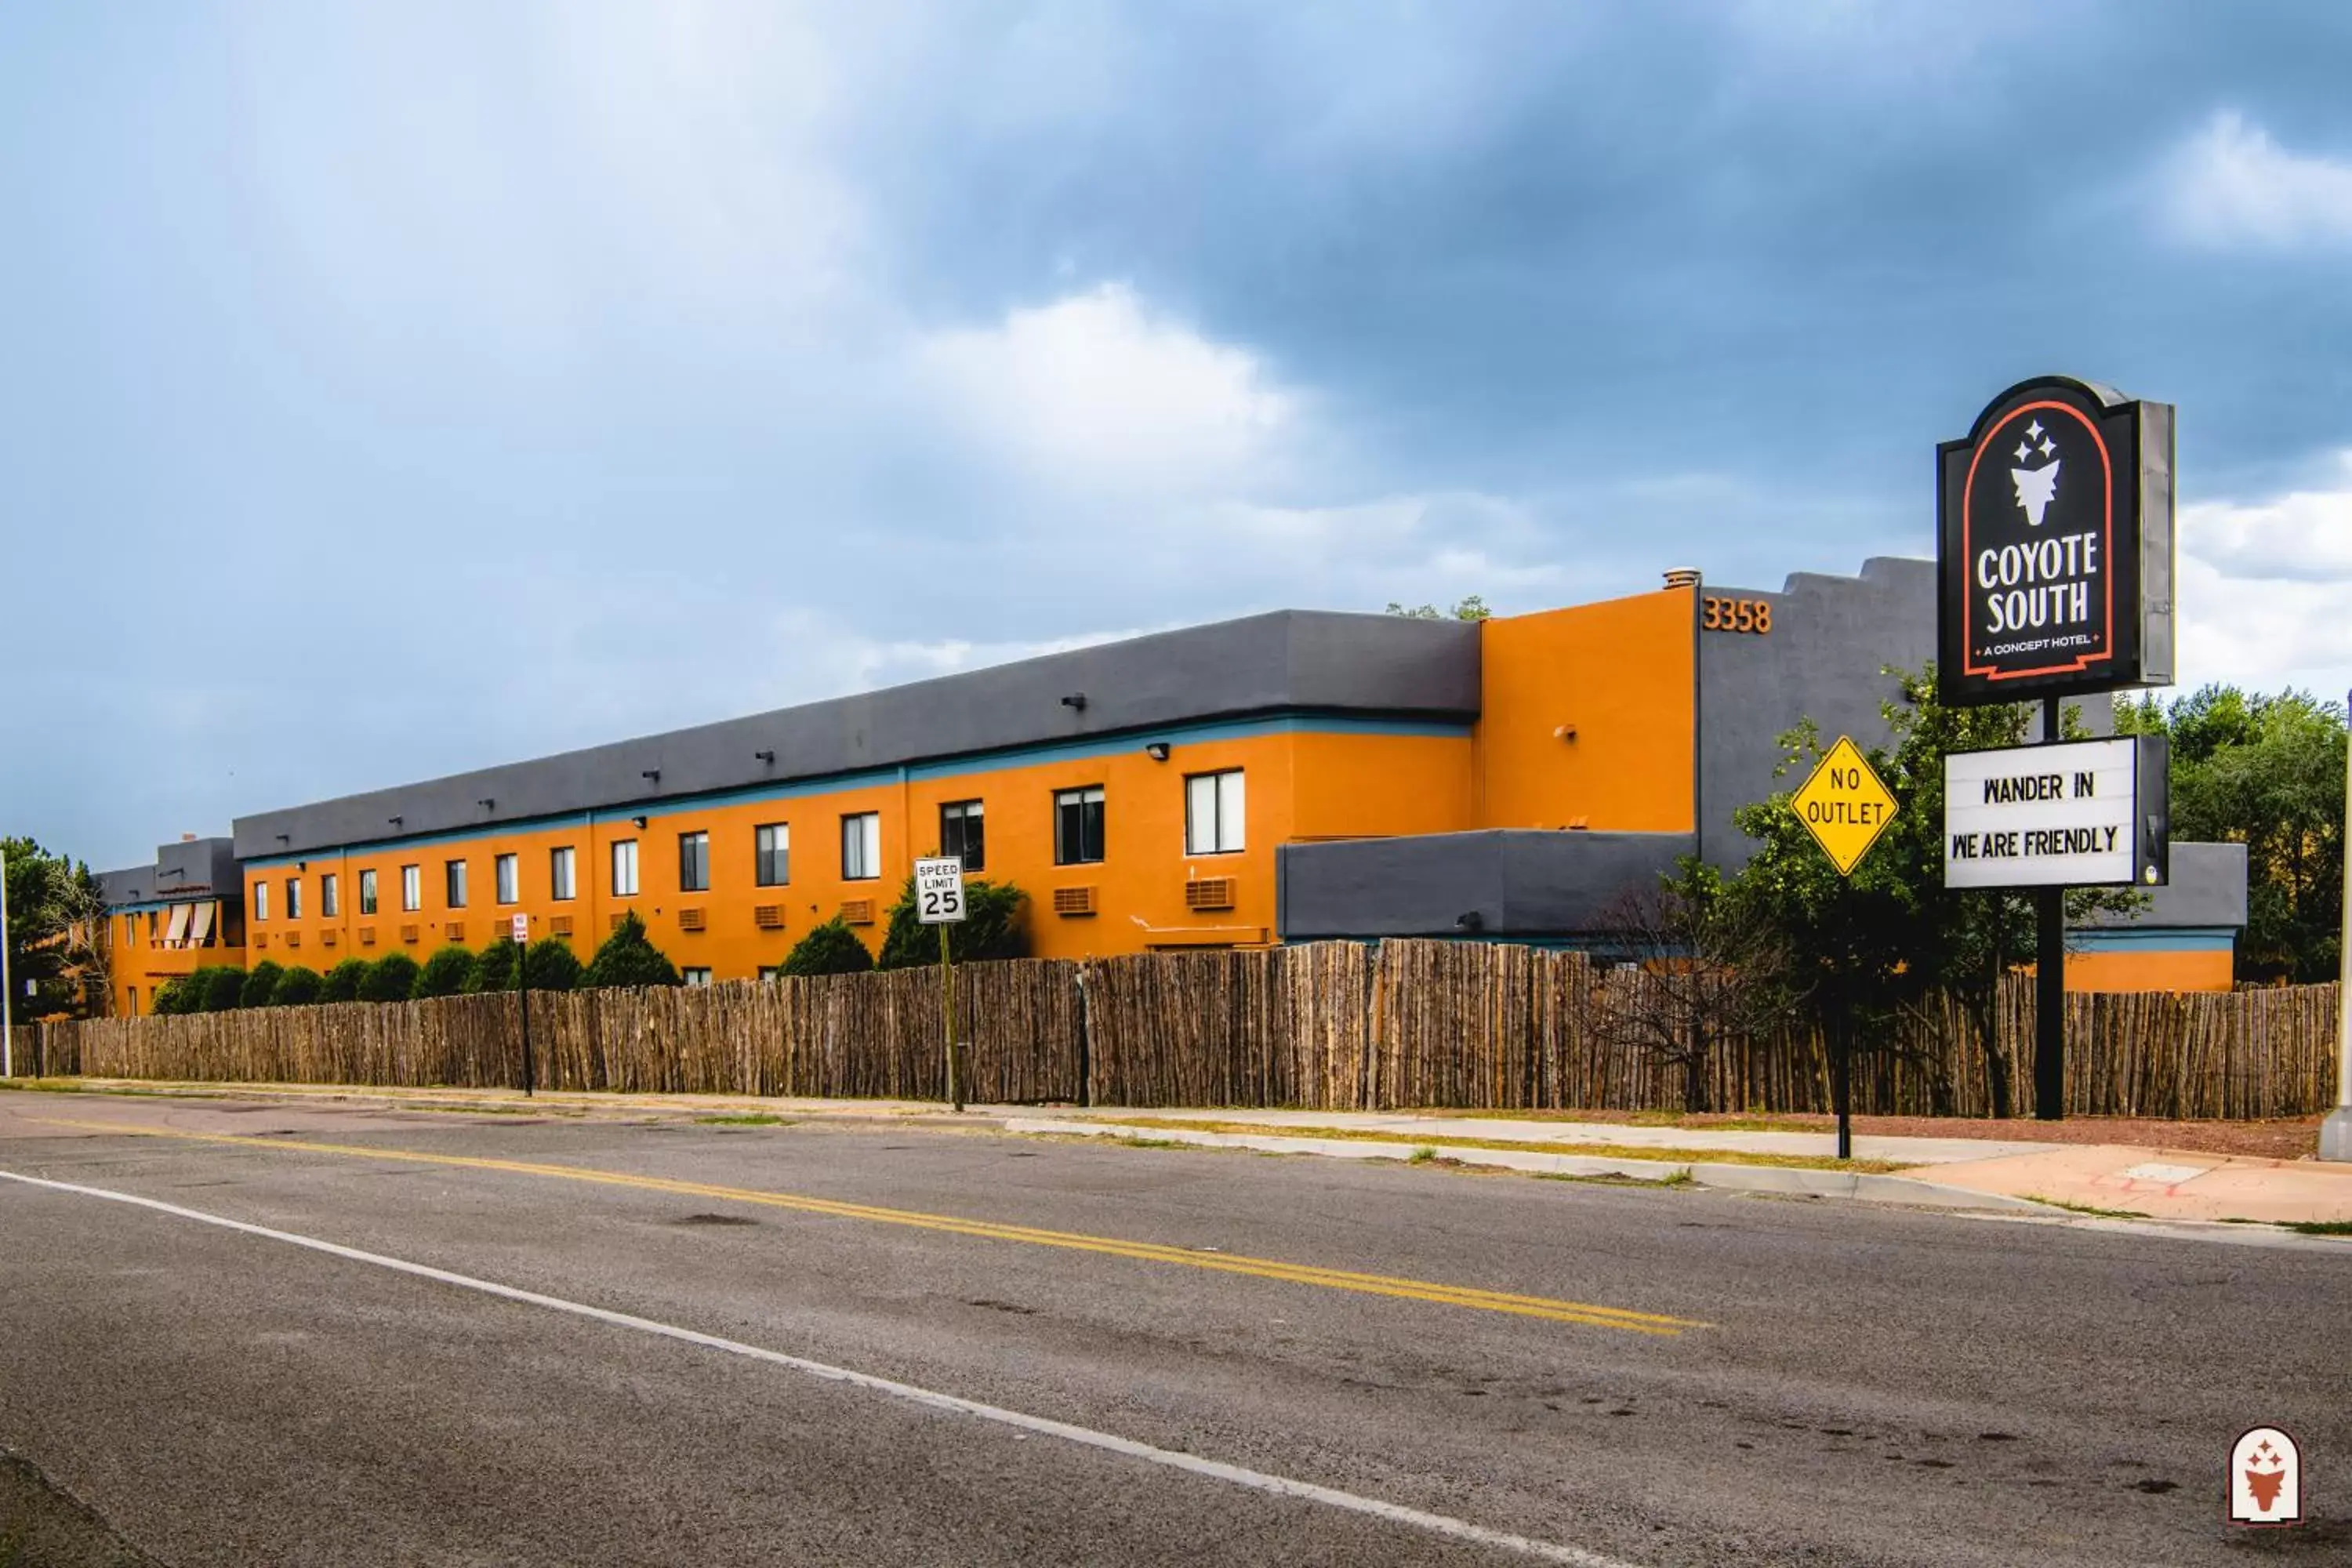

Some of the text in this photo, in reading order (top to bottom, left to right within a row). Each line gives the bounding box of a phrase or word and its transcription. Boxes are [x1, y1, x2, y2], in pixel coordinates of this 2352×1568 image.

[1977, 532, 2097, 590] COYOTE
[1703, 596, 1773, 634] 3358
[1986, 581, 2089, 634] SOUTH
[1984, 634, 2091, 656] A CONCEPT HOTEL
[1831, 768, 1860, 790] NO
[1984, 771, 2094, 804] WANDER IN
[1807, 800, 1884, 825] OUTLET
[1952, 826, 2118, 859] WE ARE FRIENDLY
[919, 865, 958, 877] SPEED
[924, 878, 954, 889] LIMIT
[924, 891, 959, 915] 25
